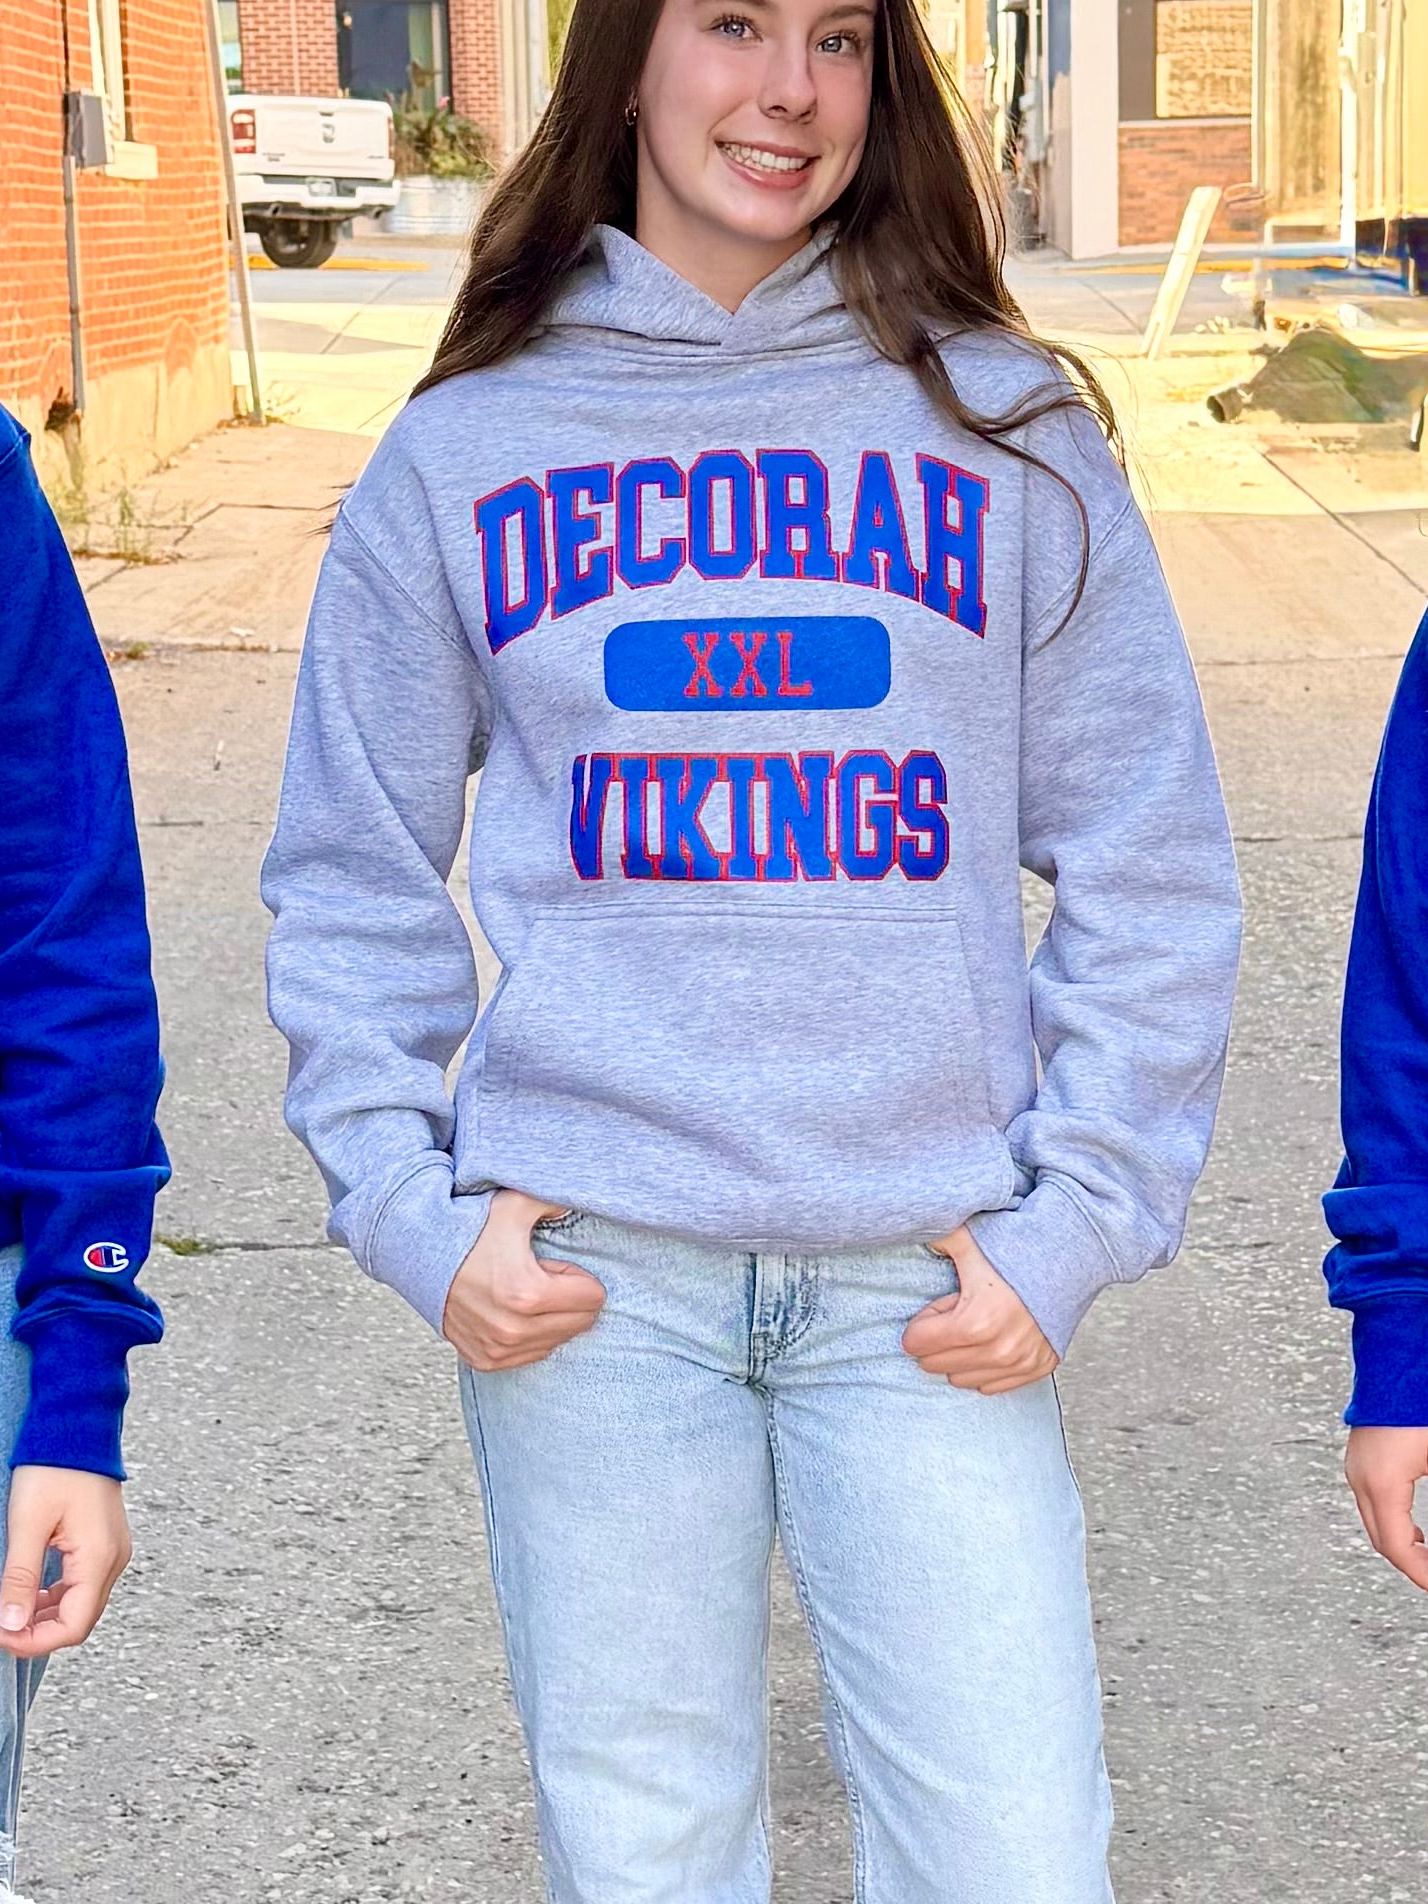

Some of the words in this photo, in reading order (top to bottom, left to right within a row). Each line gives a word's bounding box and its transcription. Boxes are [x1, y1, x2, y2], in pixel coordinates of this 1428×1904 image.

[474, 448, 990, 656] DECORAH
[682, 630, 813, 697] XXL
[569, 749, 950, 882] VIKINGS
